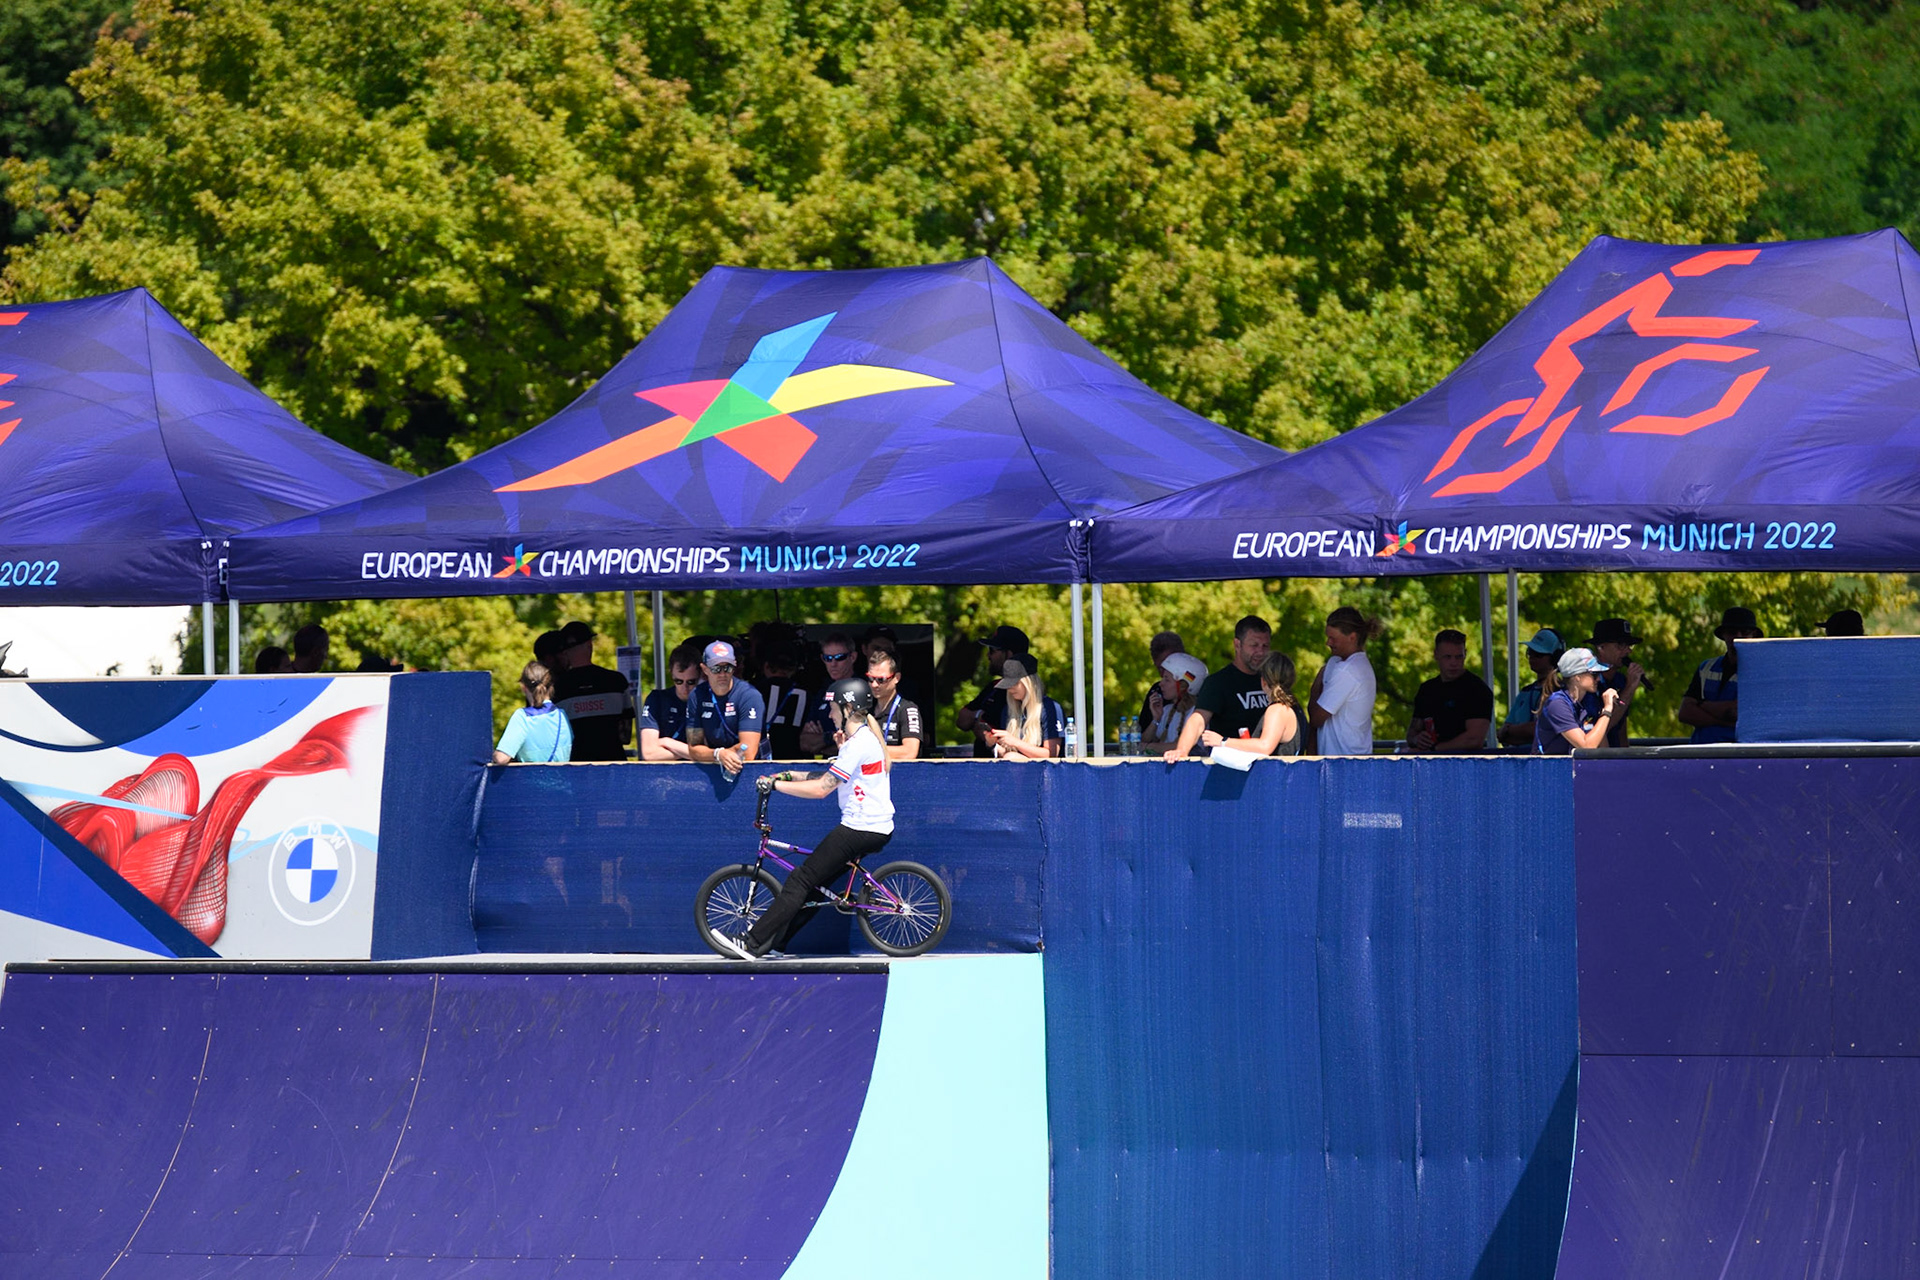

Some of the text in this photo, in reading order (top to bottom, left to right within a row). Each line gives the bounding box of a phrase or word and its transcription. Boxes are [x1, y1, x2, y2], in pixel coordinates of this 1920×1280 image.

[1232, 522, 1837, 559] EUROPEAN CHAMPIONSHIPS MUNICH 2022
[0, 560, 60, 587] 2022
[361, 543, 920, 579] EUROPEAN CHAMPIONSHIPS MUNICH 2022
[573, 699, 605, 714] SUISSE
[283, 822, 346, 851] BMW
